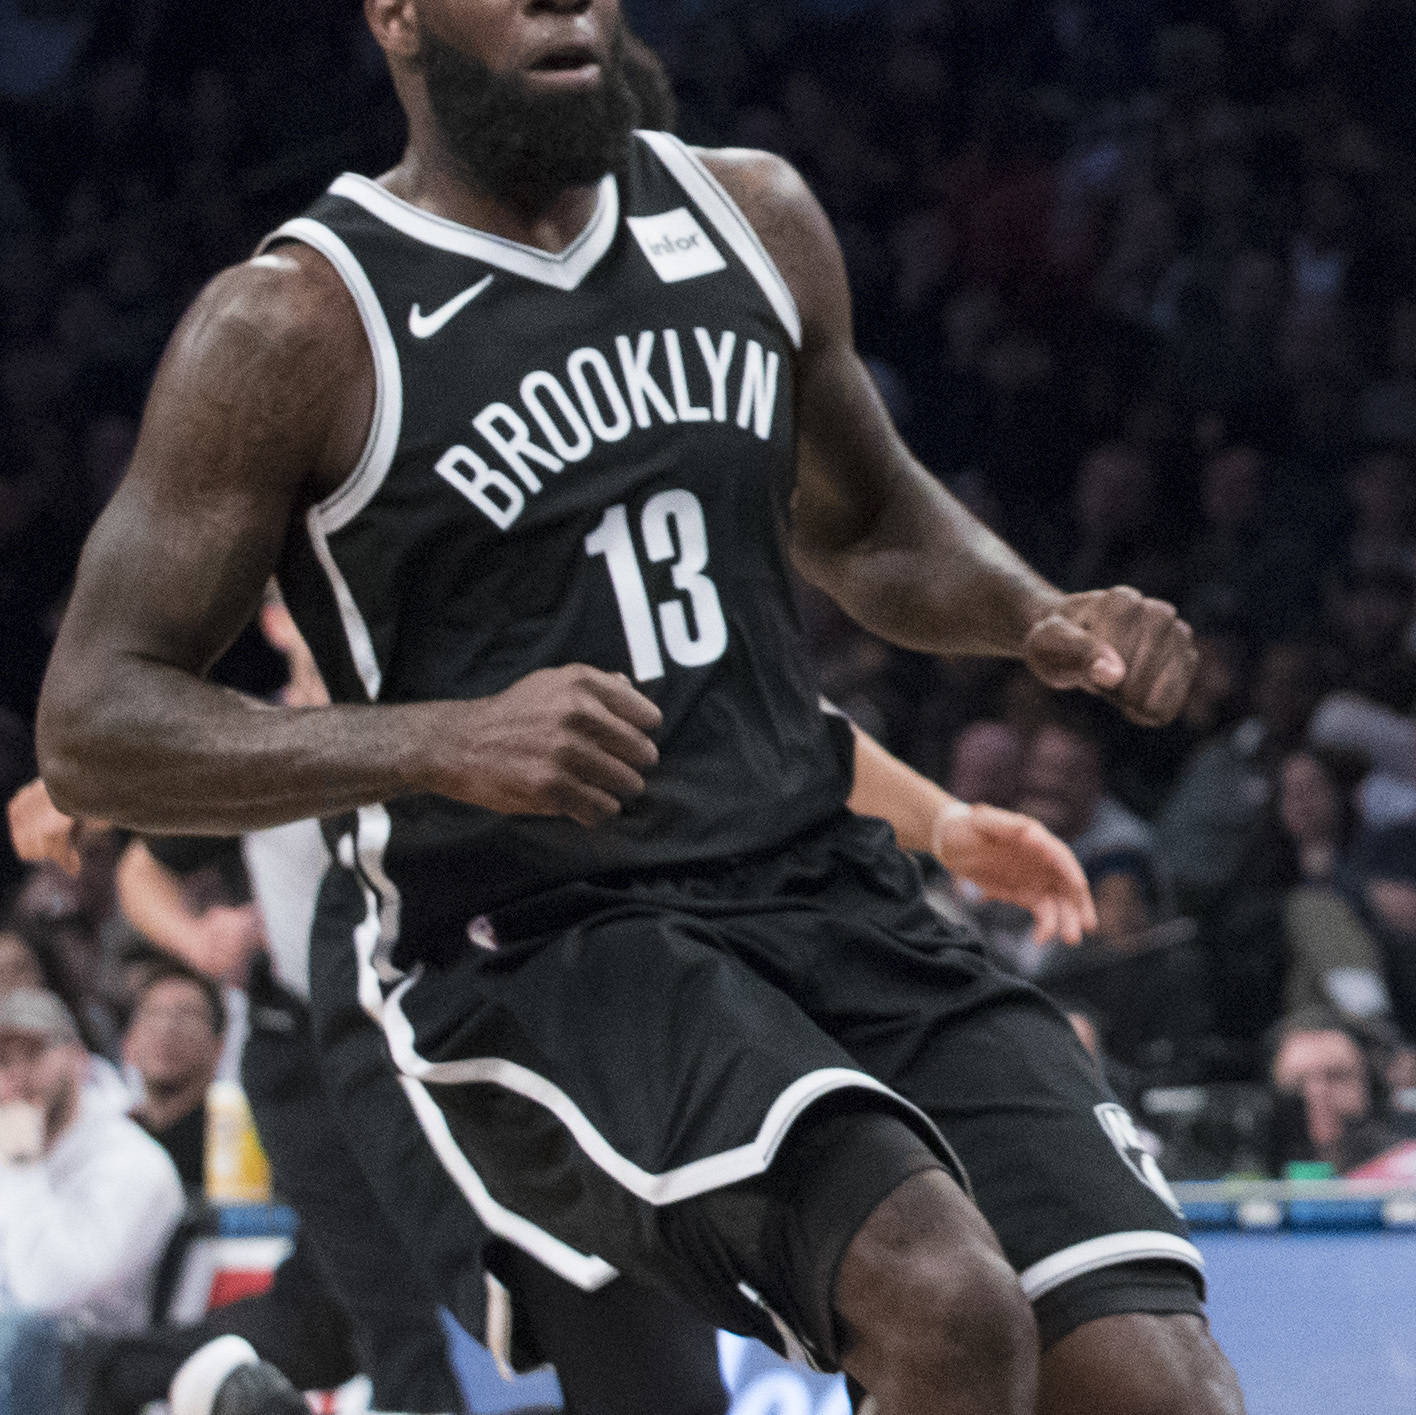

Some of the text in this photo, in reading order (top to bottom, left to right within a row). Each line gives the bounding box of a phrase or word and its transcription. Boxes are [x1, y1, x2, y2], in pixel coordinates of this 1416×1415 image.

[649, 233, 699, 256] infor
[433, 326, 781, 532] BROOKLYN
[584, 487, 729, 683] 13
